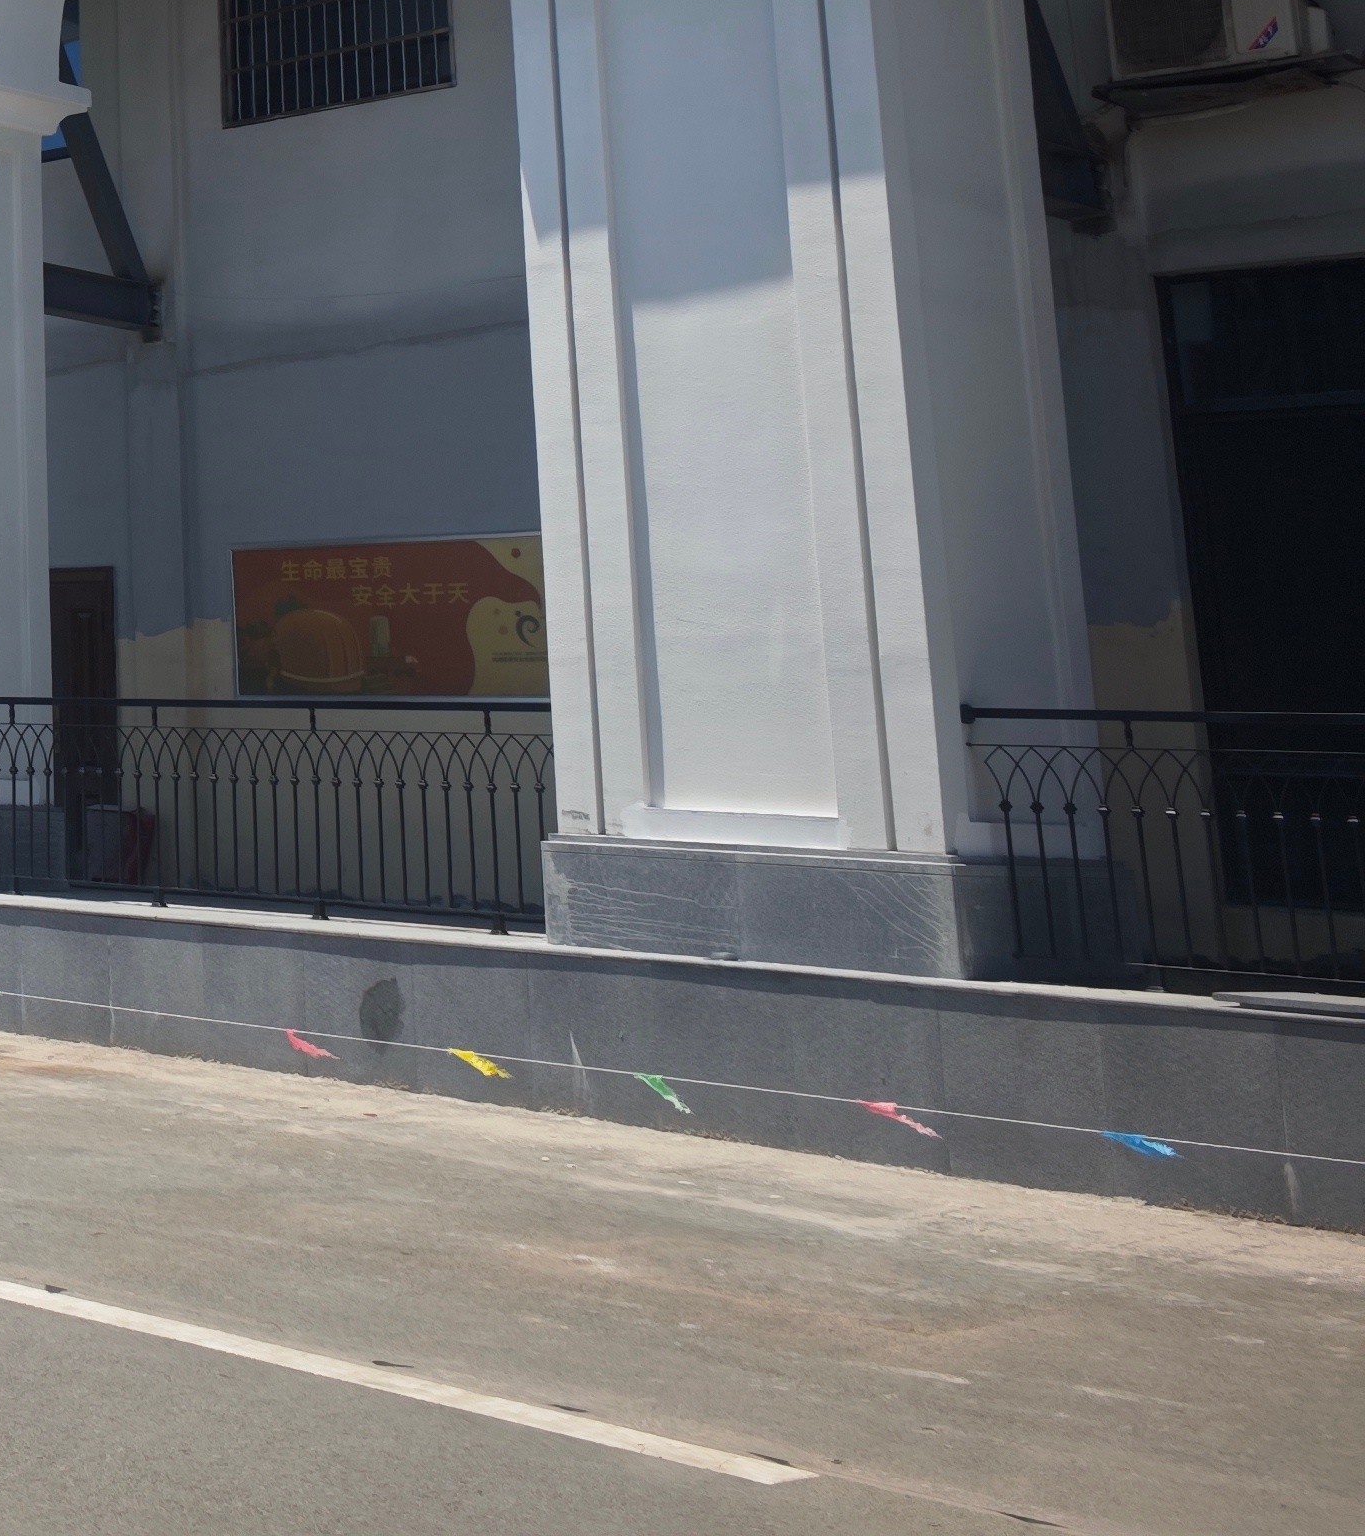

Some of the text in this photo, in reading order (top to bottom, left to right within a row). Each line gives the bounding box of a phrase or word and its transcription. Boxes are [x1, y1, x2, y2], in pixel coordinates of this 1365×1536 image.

[280, 555, 393, 582] 生命最宝贵
[351, 582, 470, 607] 安全大于天
